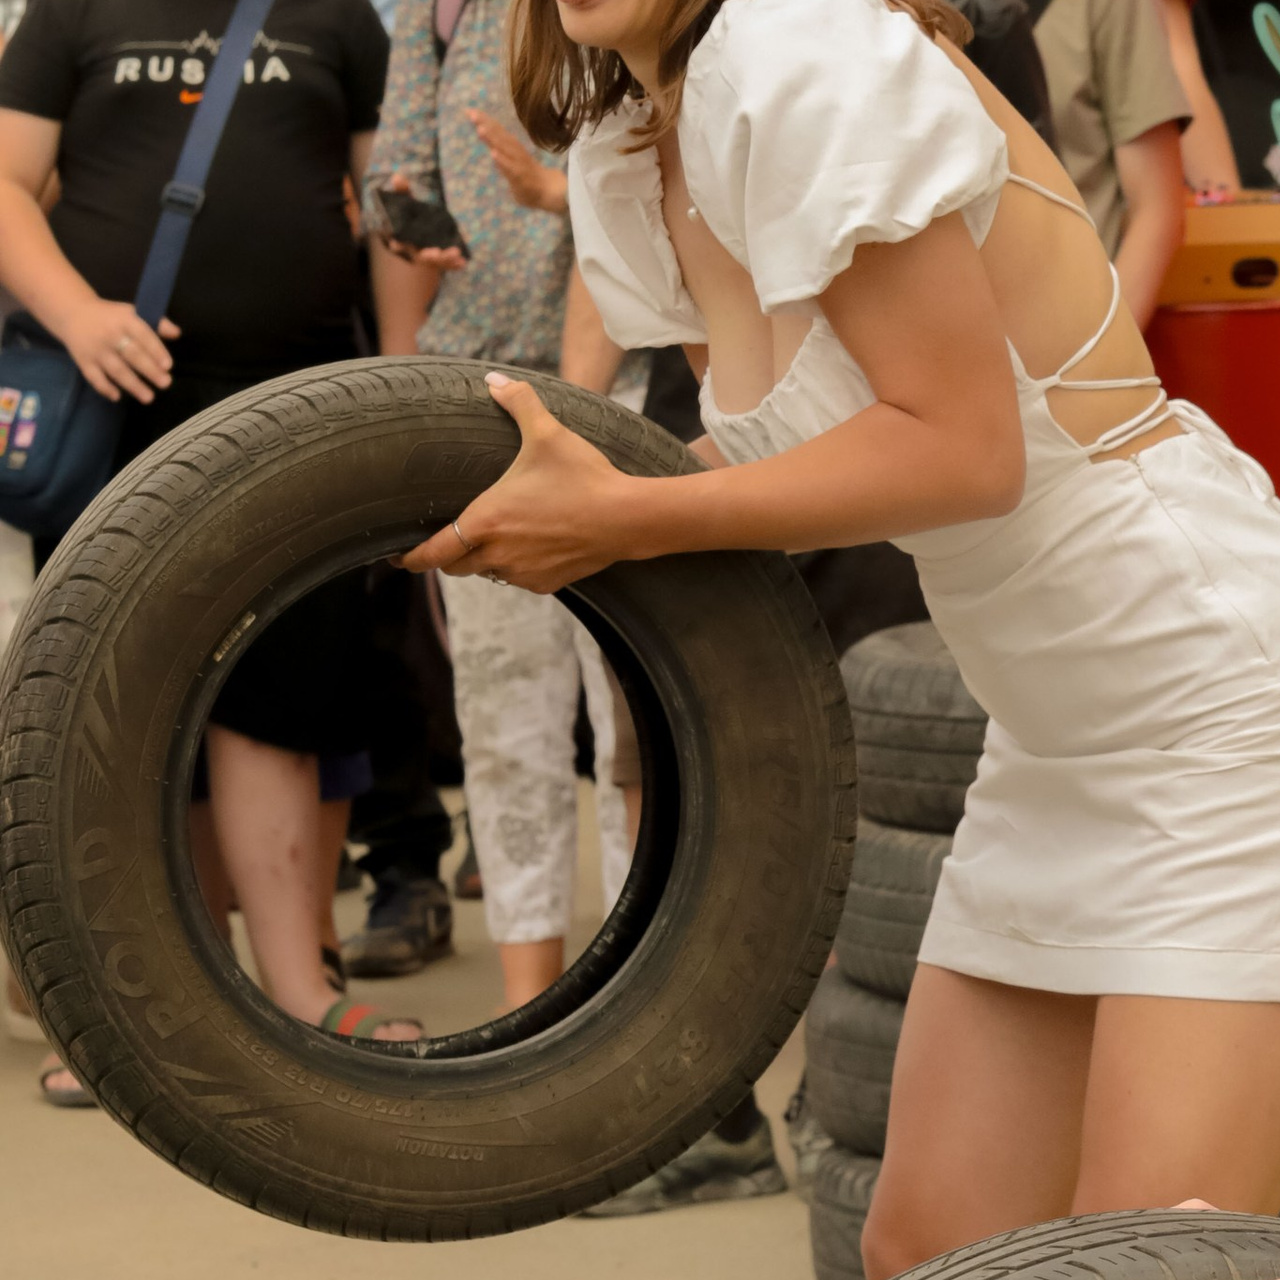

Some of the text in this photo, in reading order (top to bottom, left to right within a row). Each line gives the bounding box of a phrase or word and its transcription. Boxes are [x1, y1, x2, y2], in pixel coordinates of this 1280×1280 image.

[114, 55, 292, 85] RUSIA
[232, 1024, 414, 1117] 175/70 R13 82T
